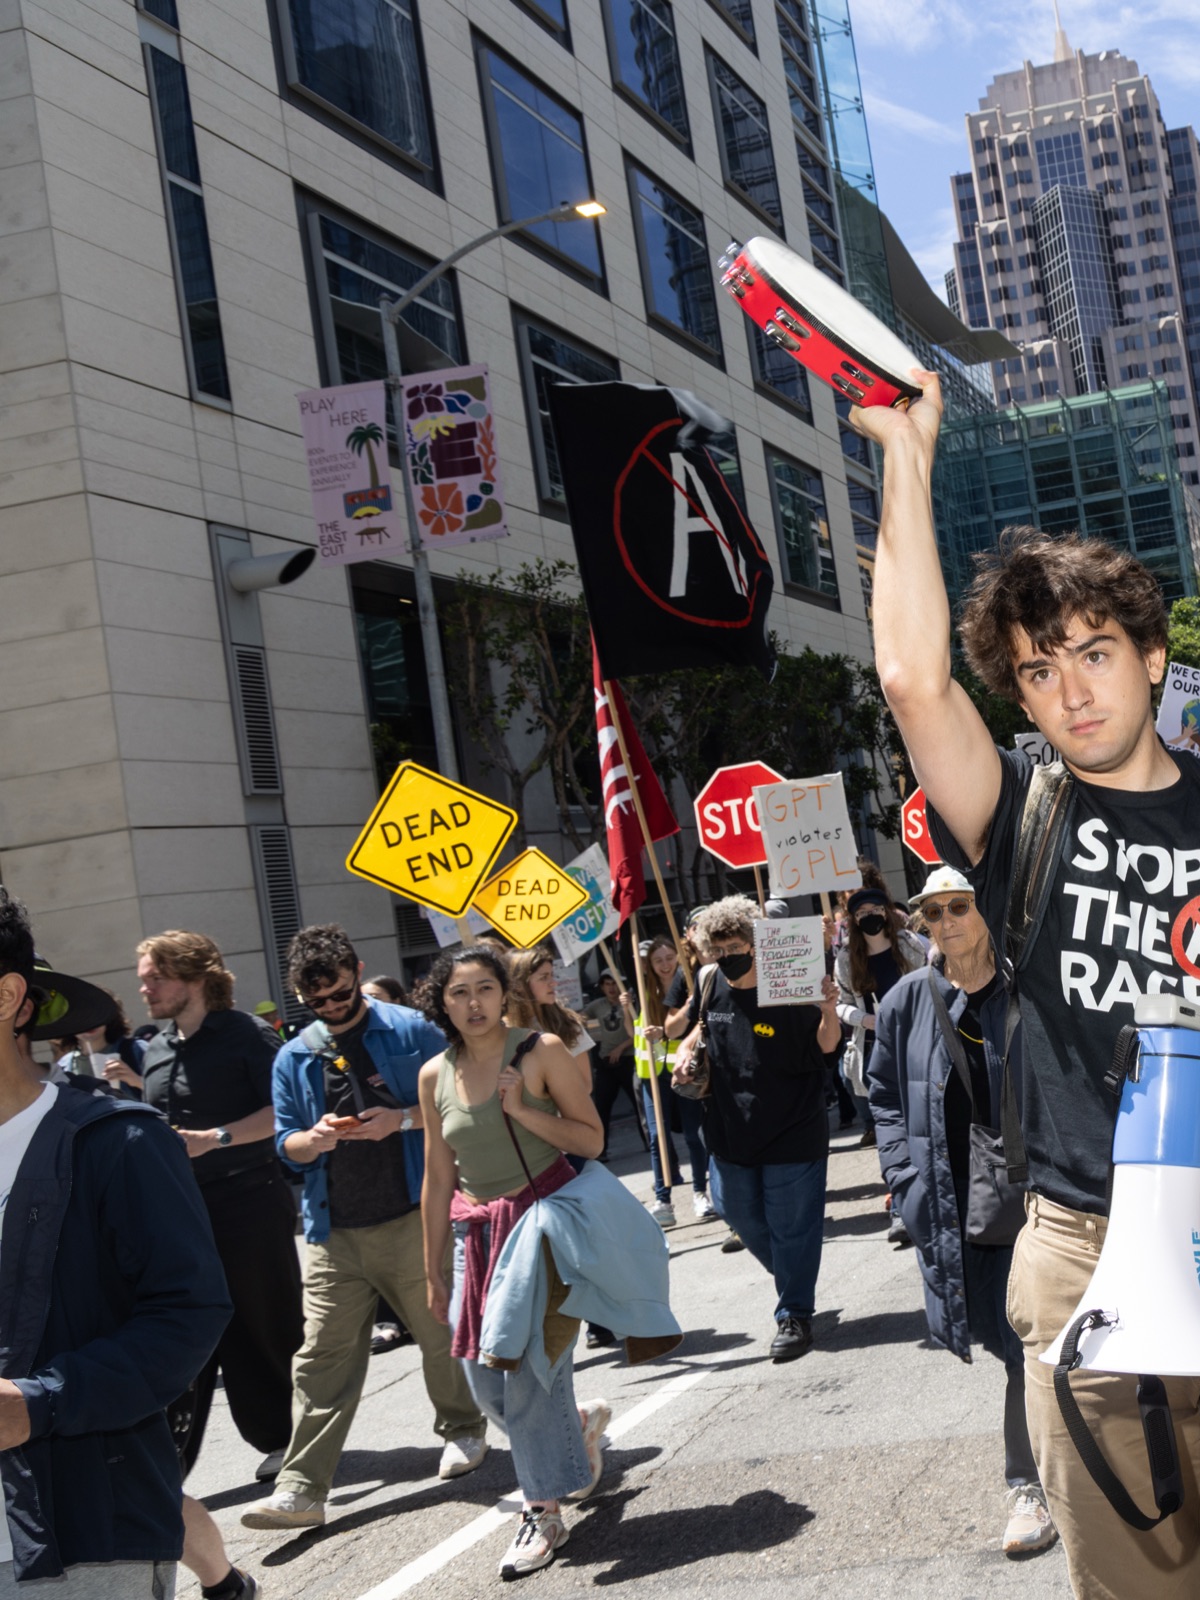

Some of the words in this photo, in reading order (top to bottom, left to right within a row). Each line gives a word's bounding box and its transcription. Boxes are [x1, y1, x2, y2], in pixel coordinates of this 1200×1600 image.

[300, 398, 335, 415] PLAY
[329, 409, 368, 427] HERE
[309, 454, 338, 466] EVENTS
[339, 451, 351, 461] TO
[310, 460, 357, 477] EXPERIENCE
[312, 472, 351, 486] ANNUALLY
[318, 521, 339, 534] THE
[320, 531, 347, 546] EAST
[321, 544, 345, 557] CUT
[1171, 664, 1189, 677] WE
[1173, 680, 1200, 696] OUR
[766, 784, 831, 822] GPT
[380, 801, 471, 848] DEAD
[703, 796, 761, 840] STO
[776, 828, 842, 848] violates
[406, 842, 473, 883] END
[780, 845, 856, 889] GPL
[497, 879, 560, 896] DEAD
[505, 904, 551, 921] END
[1063, 882, 1173, 965] THE
[764, 928, 781, 938] THE
[760, 935, 811, 949] INDUSTRIAL
[761, 948, 812, 961] REVOLUTION
[762, 970, 788, 979] SOLVE
[791, 968, 808, 977] ITS
[768, 986, 813, 998] PROBLEMS
